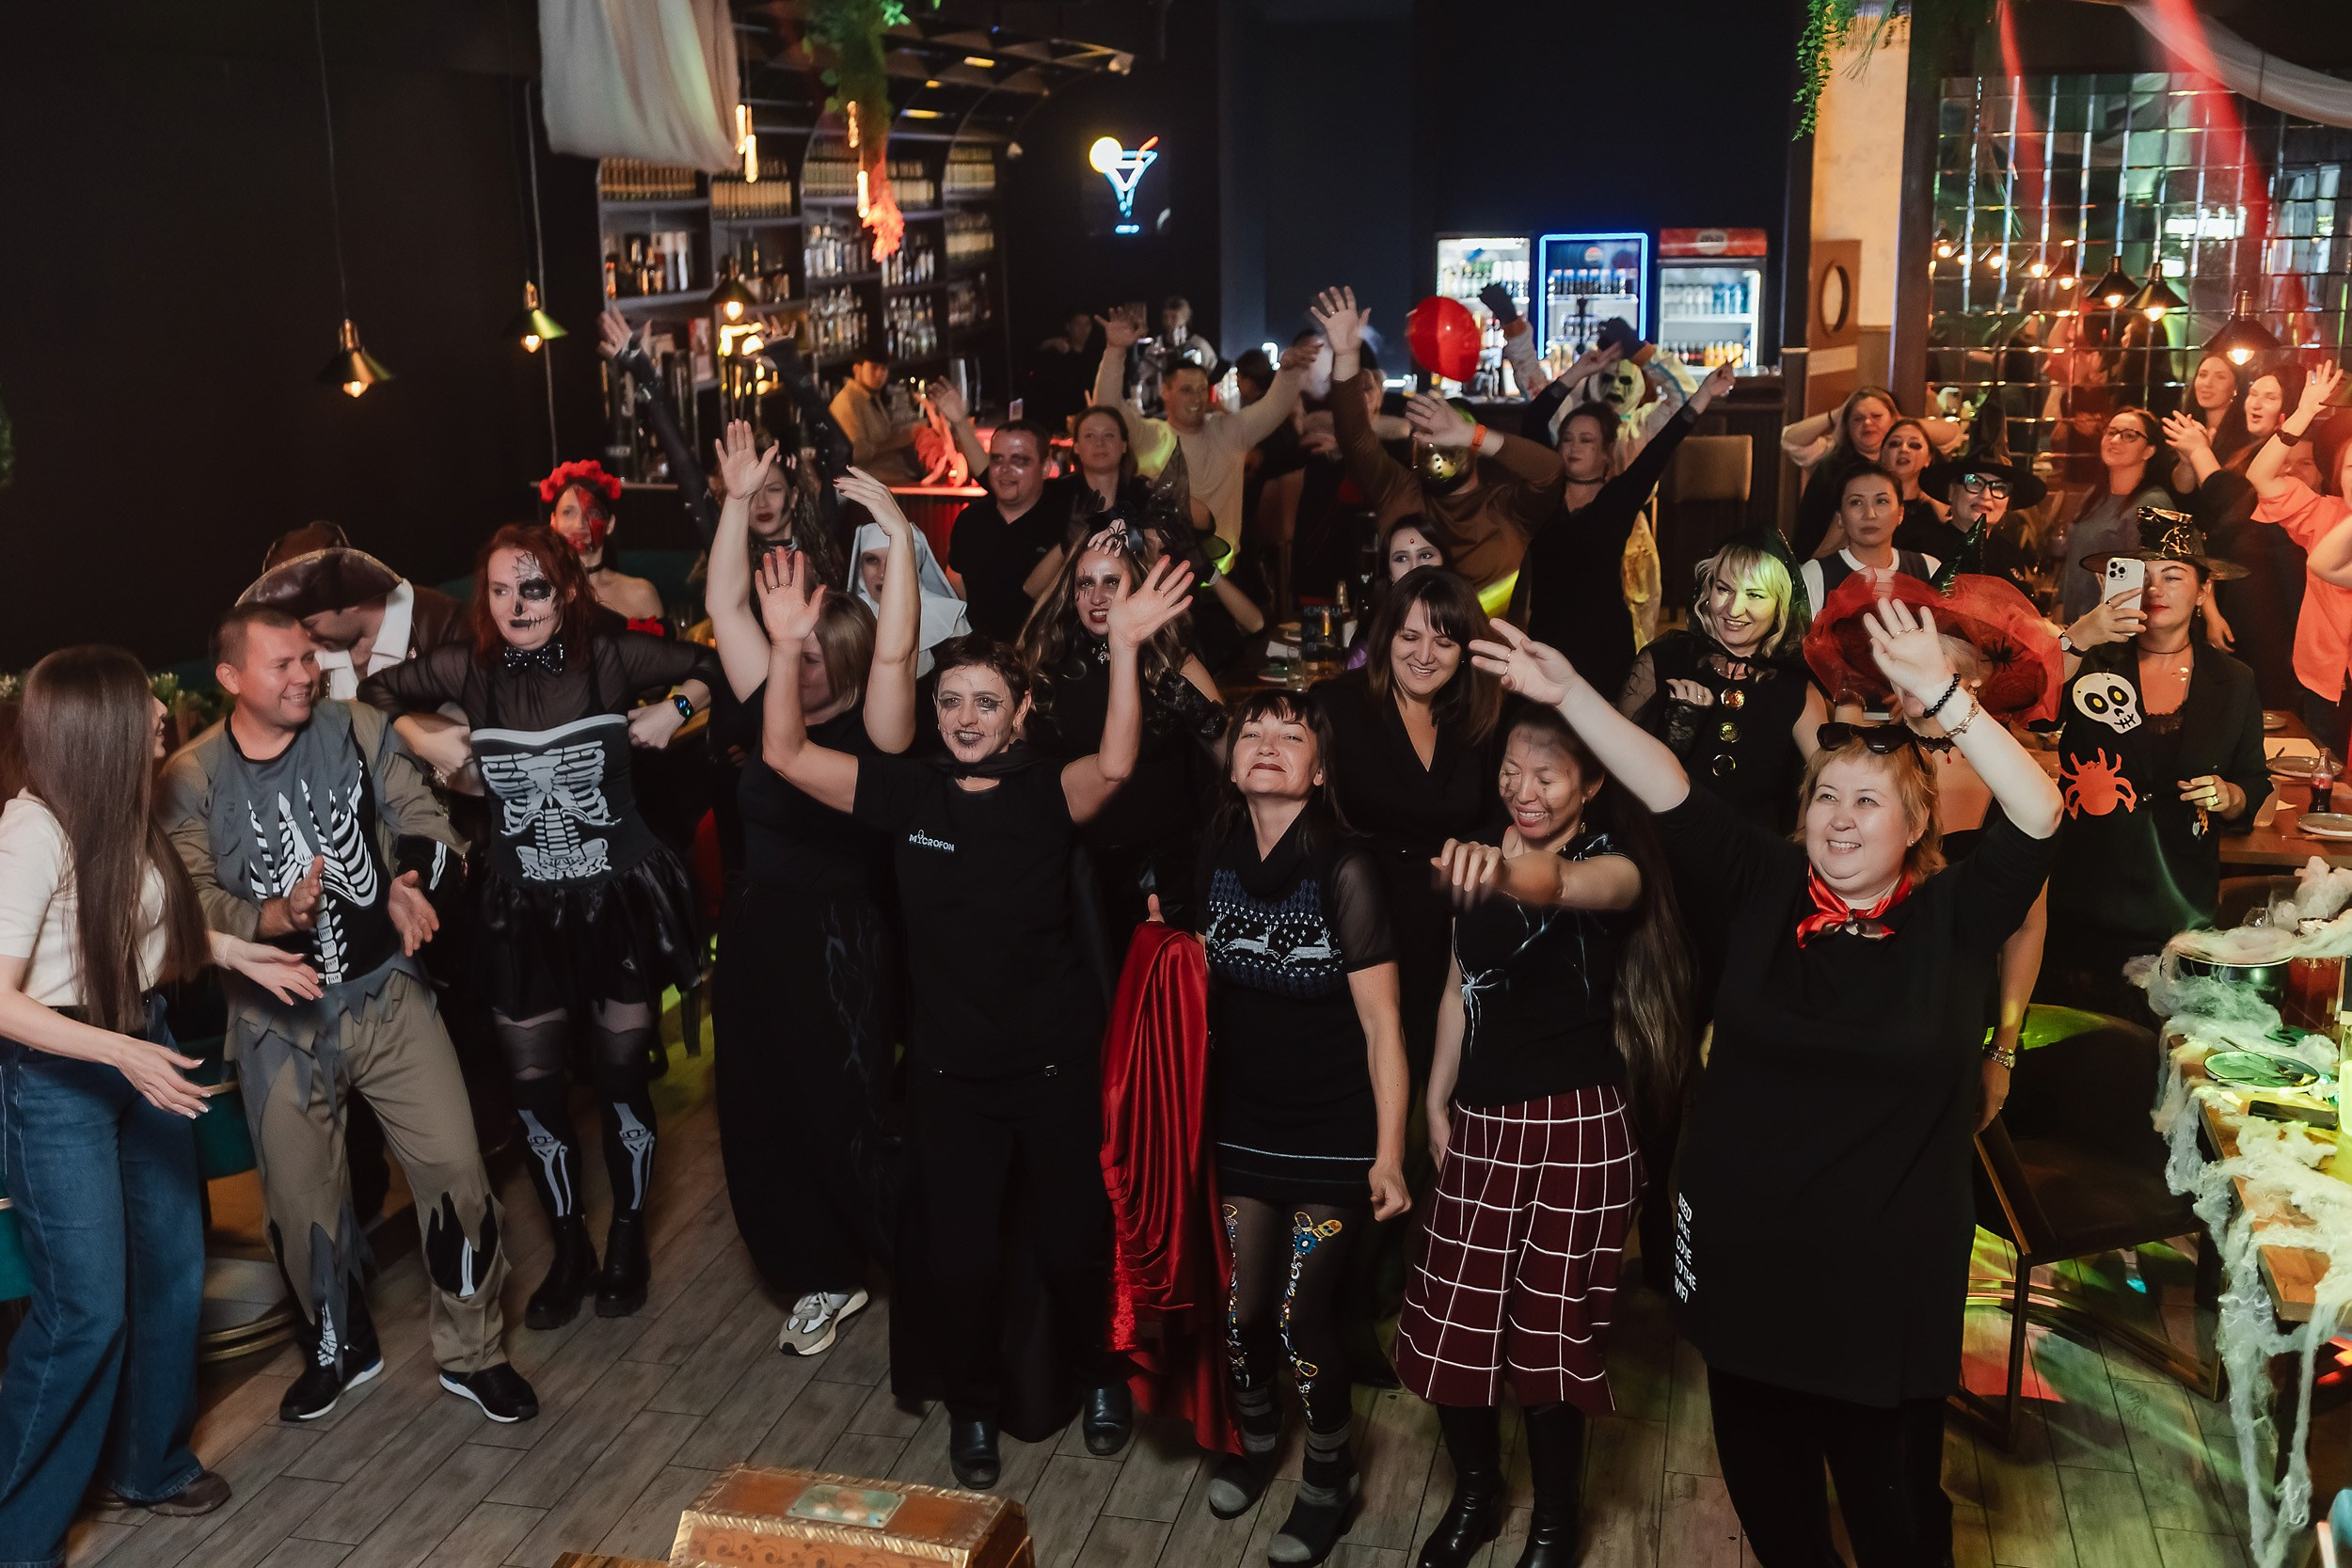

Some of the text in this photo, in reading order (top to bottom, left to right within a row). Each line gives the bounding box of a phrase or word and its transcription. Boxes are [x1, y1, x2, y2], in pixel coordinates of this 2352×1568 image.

[909, 830, 955, 852] MICROFON
[1678, 1192, 1692, 1222] NEED
[1677, 1212, 1691, 1243] THAT
[1676, 1234, 1692, 1265] CODE
[1675, 1254, 1696, 1291] TO THE
